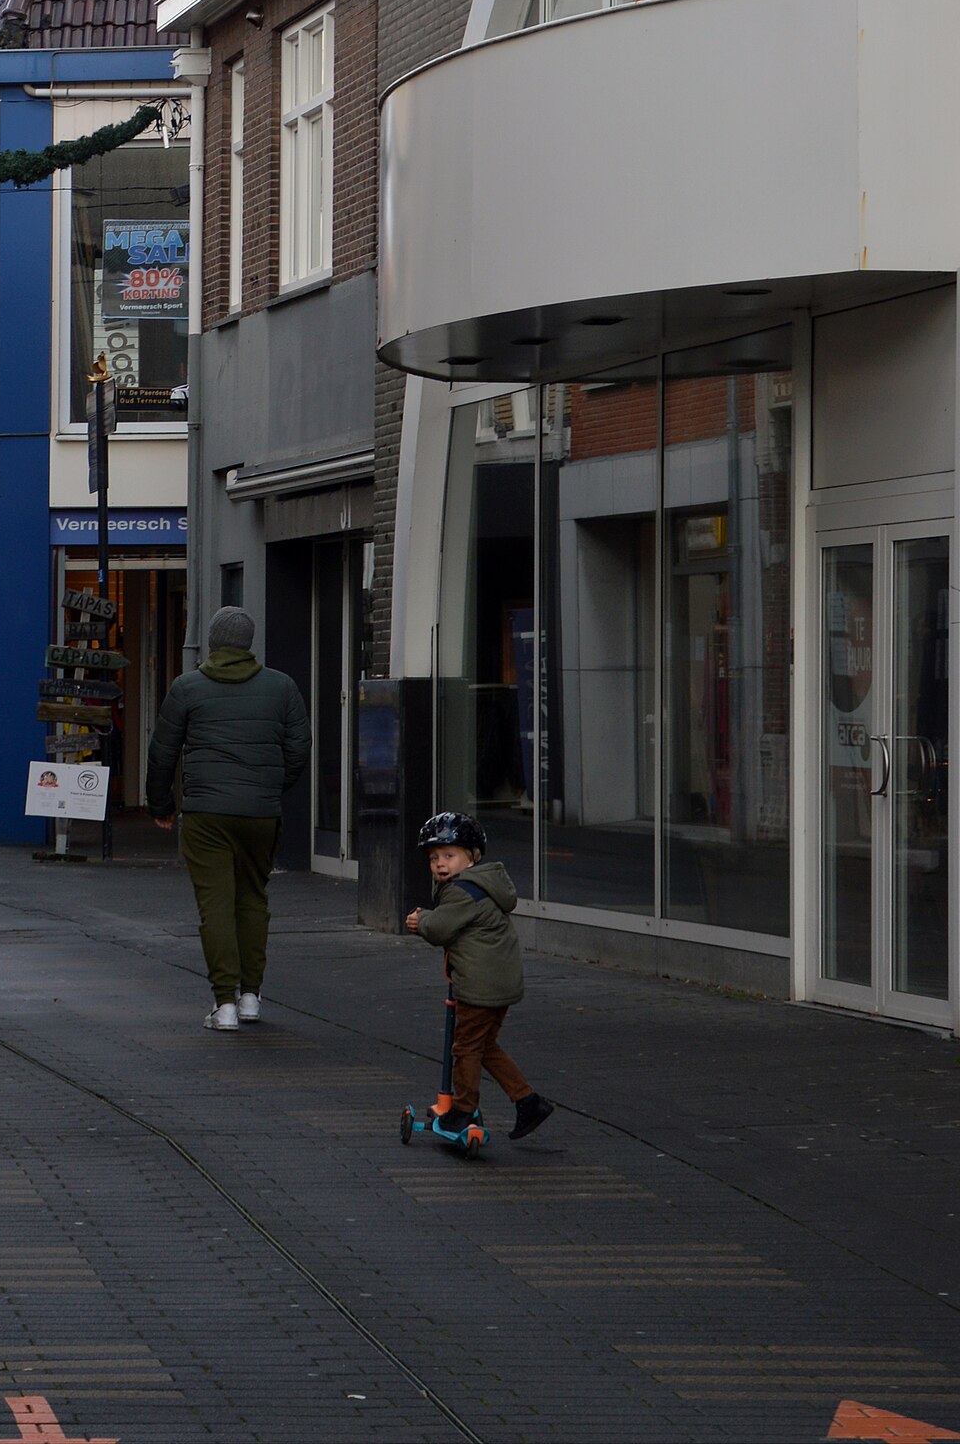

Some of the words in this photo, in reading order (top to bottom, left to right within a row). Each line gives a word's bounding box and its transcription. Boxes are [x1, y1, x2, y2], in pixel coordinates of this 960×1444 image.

[105, 230, 184, 250] MEGA
[123, 288, 180, 301] KORTING
[163, 302, 183, 311] Sport
[68, 590, 114, 616] TAPAS
[69, 623, 99, 636] BAR
[838, 724, 866, 746] arca
